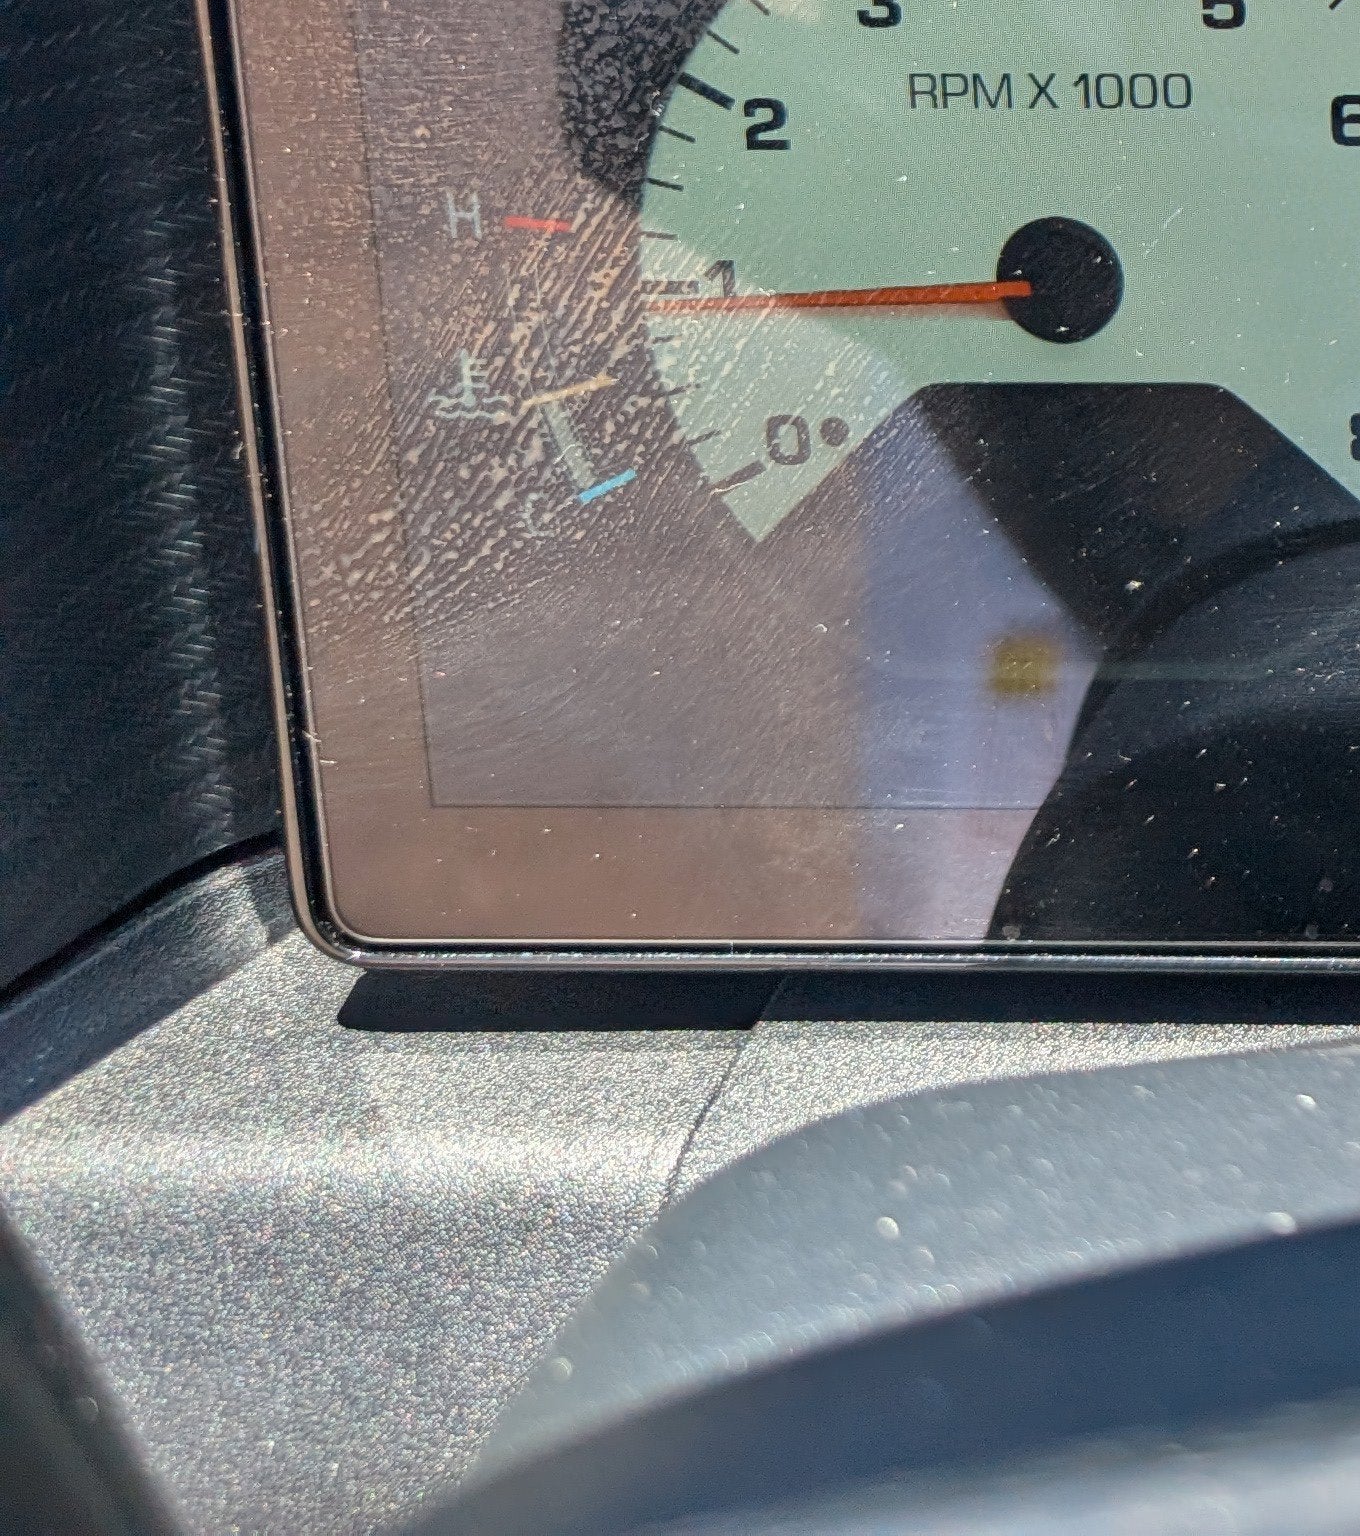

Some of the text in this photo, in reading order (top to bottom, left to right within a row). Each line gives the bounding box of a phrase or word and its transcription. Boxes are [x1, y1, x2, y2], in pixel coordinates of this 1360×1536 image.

[908, 72, 1194, 111] RPM X 1000
[743, 97, 791, 151] 2
[446, 191, 484, 240] H
[704, 259, 736, 296] 1
